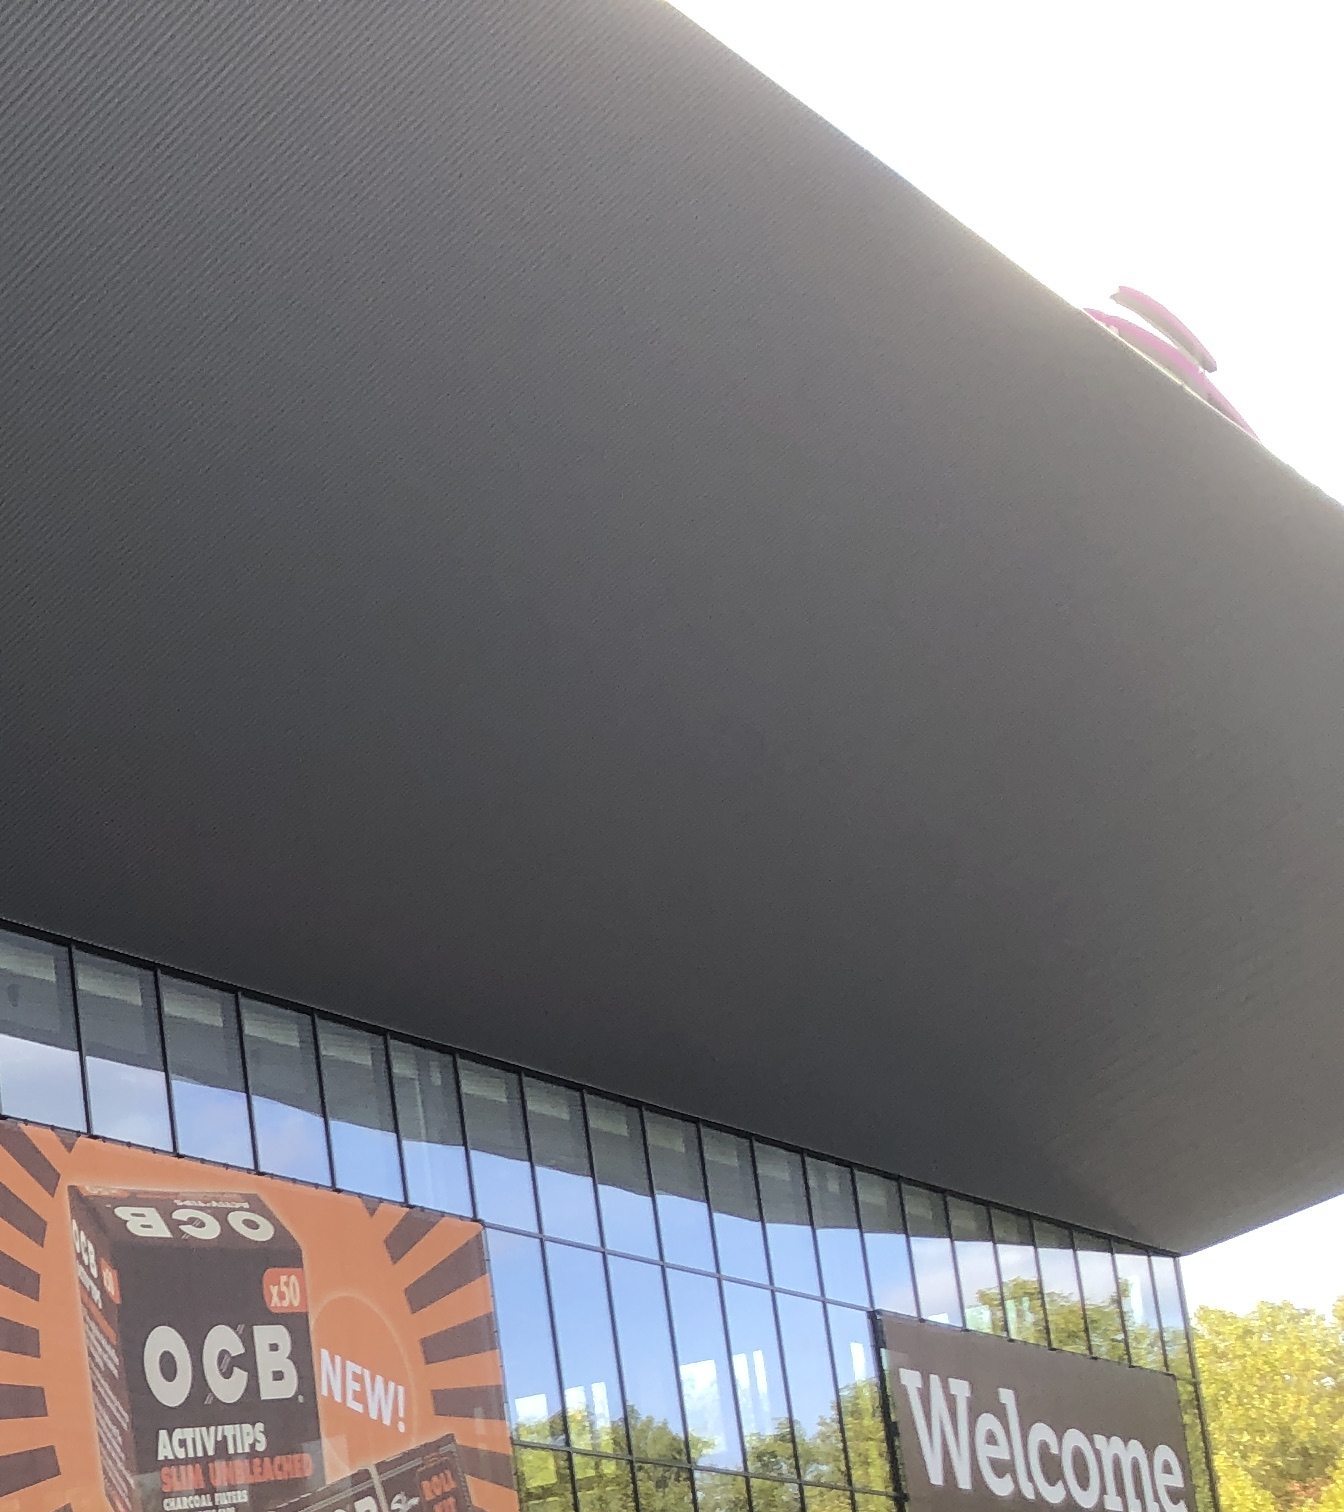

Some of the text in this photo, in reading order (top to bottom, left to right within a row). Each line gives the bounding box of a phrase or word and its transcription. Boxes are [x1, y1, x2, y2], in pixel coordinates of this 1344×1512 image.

[269, 1274, 301, 1307] x50
[143, 1324, 300, 1408] OCB
[320, 1348, 406, 1433] NEW!
[157, 1422, 267, 1461] ACTIV'TIPS
[162, 1493, 213, 1511] CHARCOAL
